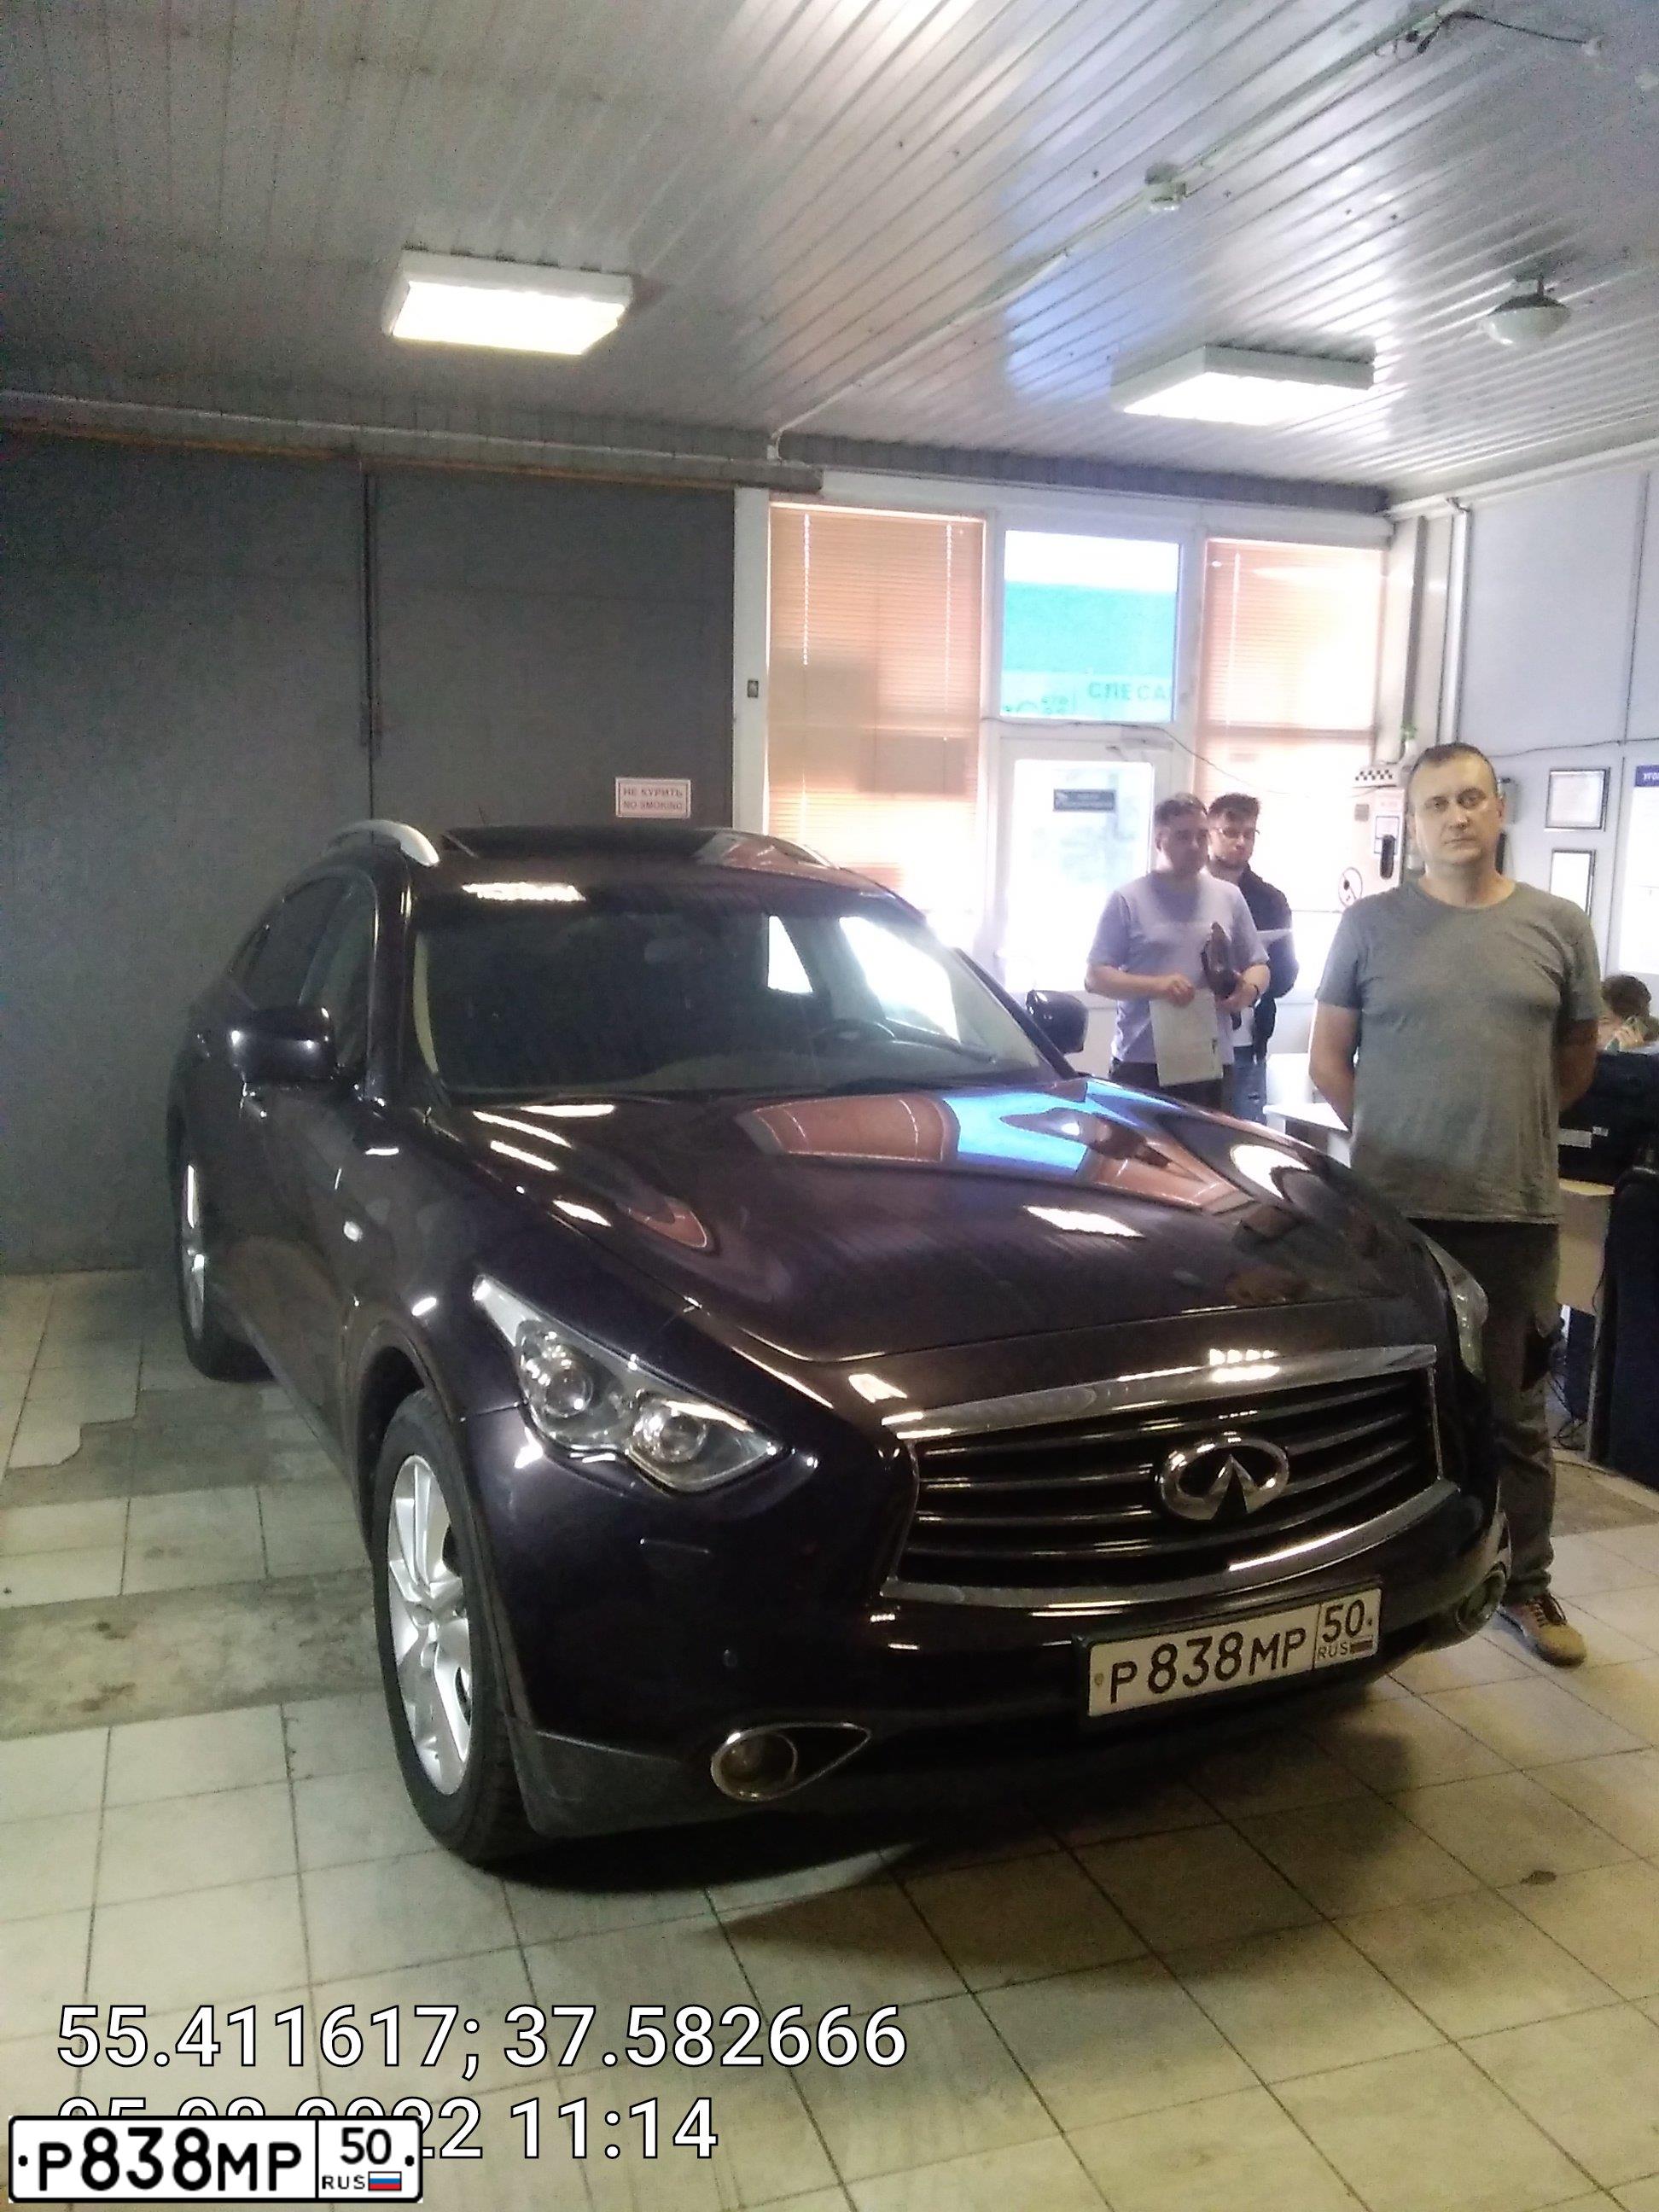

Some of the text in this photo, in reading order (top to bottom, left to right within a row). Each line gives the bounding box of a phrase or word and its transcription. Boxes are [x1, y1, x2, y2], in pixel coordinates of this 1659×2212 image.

[623, 787, 683, 797] НЕ КУРИТЬ
[623, 800, 683, 810] NO SMOKING
[1110, 1599, 1365, 1704] Р838МР 50
[1317, 1640, 1348, 1662] RUS
